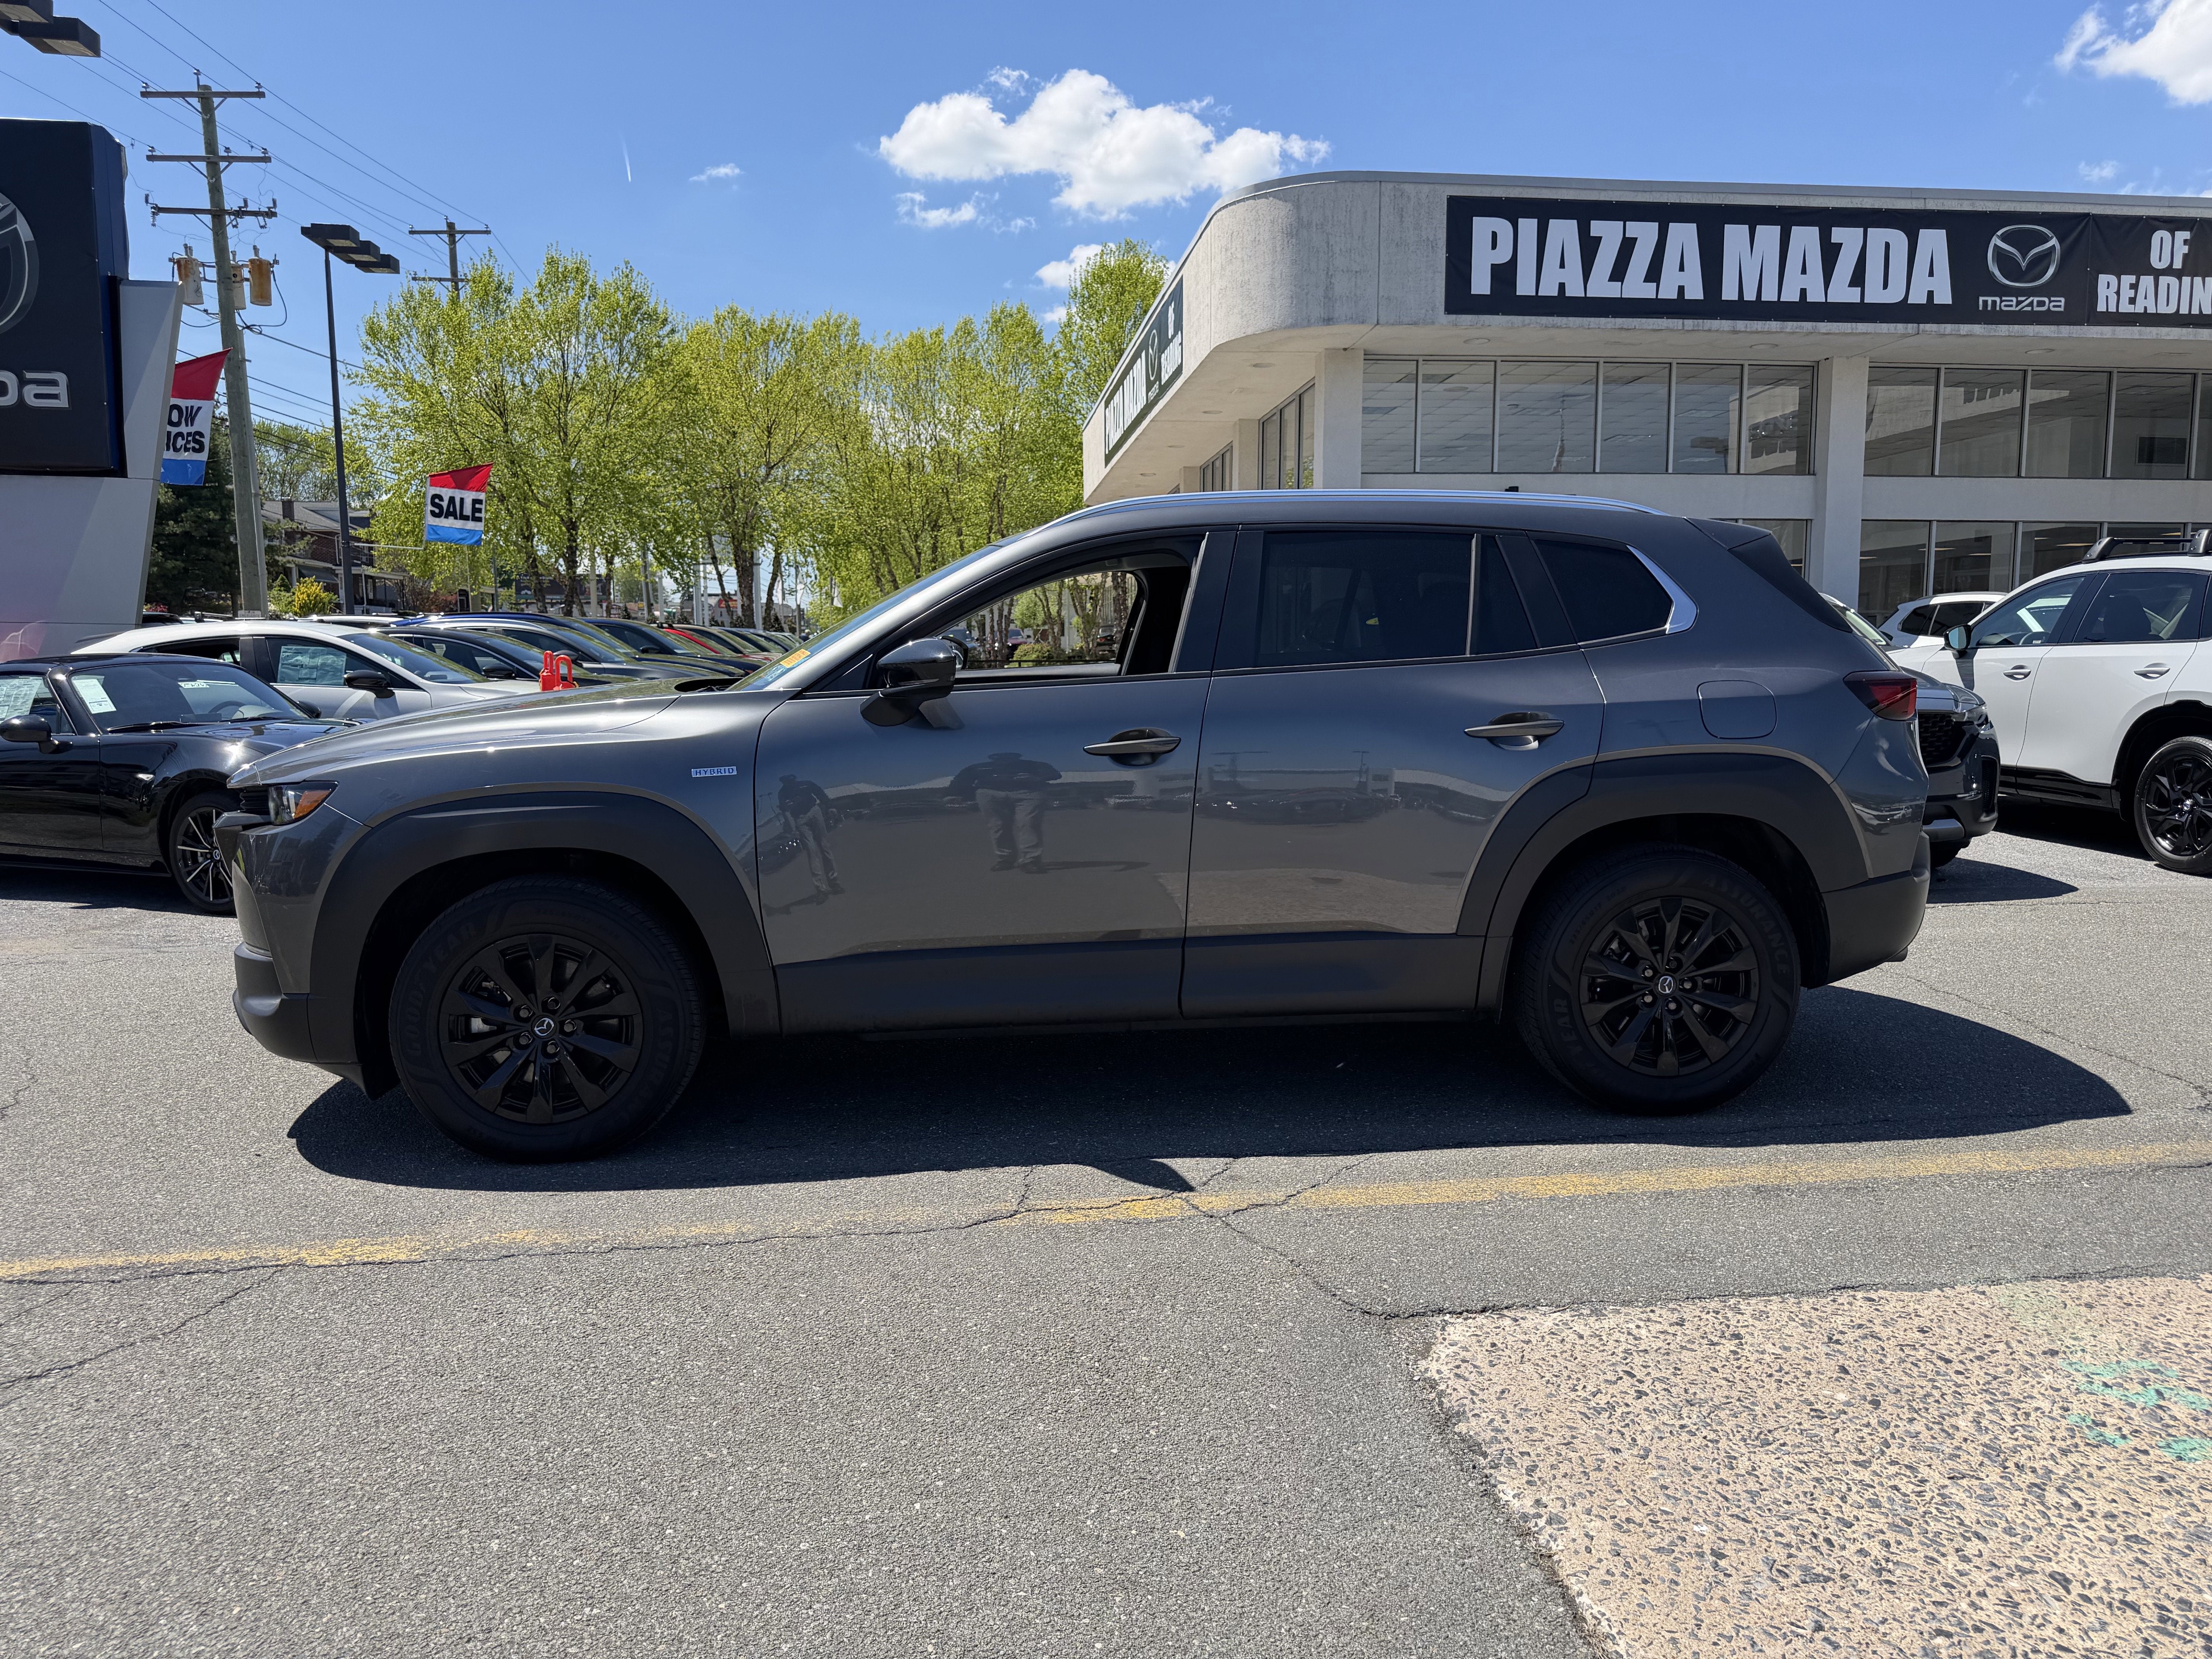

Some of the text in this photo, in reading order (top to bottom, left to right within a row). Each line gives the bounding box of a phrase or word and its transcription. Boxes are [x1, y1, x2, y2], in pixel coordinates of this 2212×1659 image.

[1471, 216, 1952, 304] PIAZZA MAZDA
[2150, 230, 2190, 269] OF
[2097, 274, 2212, 314] READIN
[167, 404, 203, 428] OW
[165, 430, 205, 453] ICES
[429, 493, 484, 523] SALE
[695, 768, 734, 776] HYBRID
